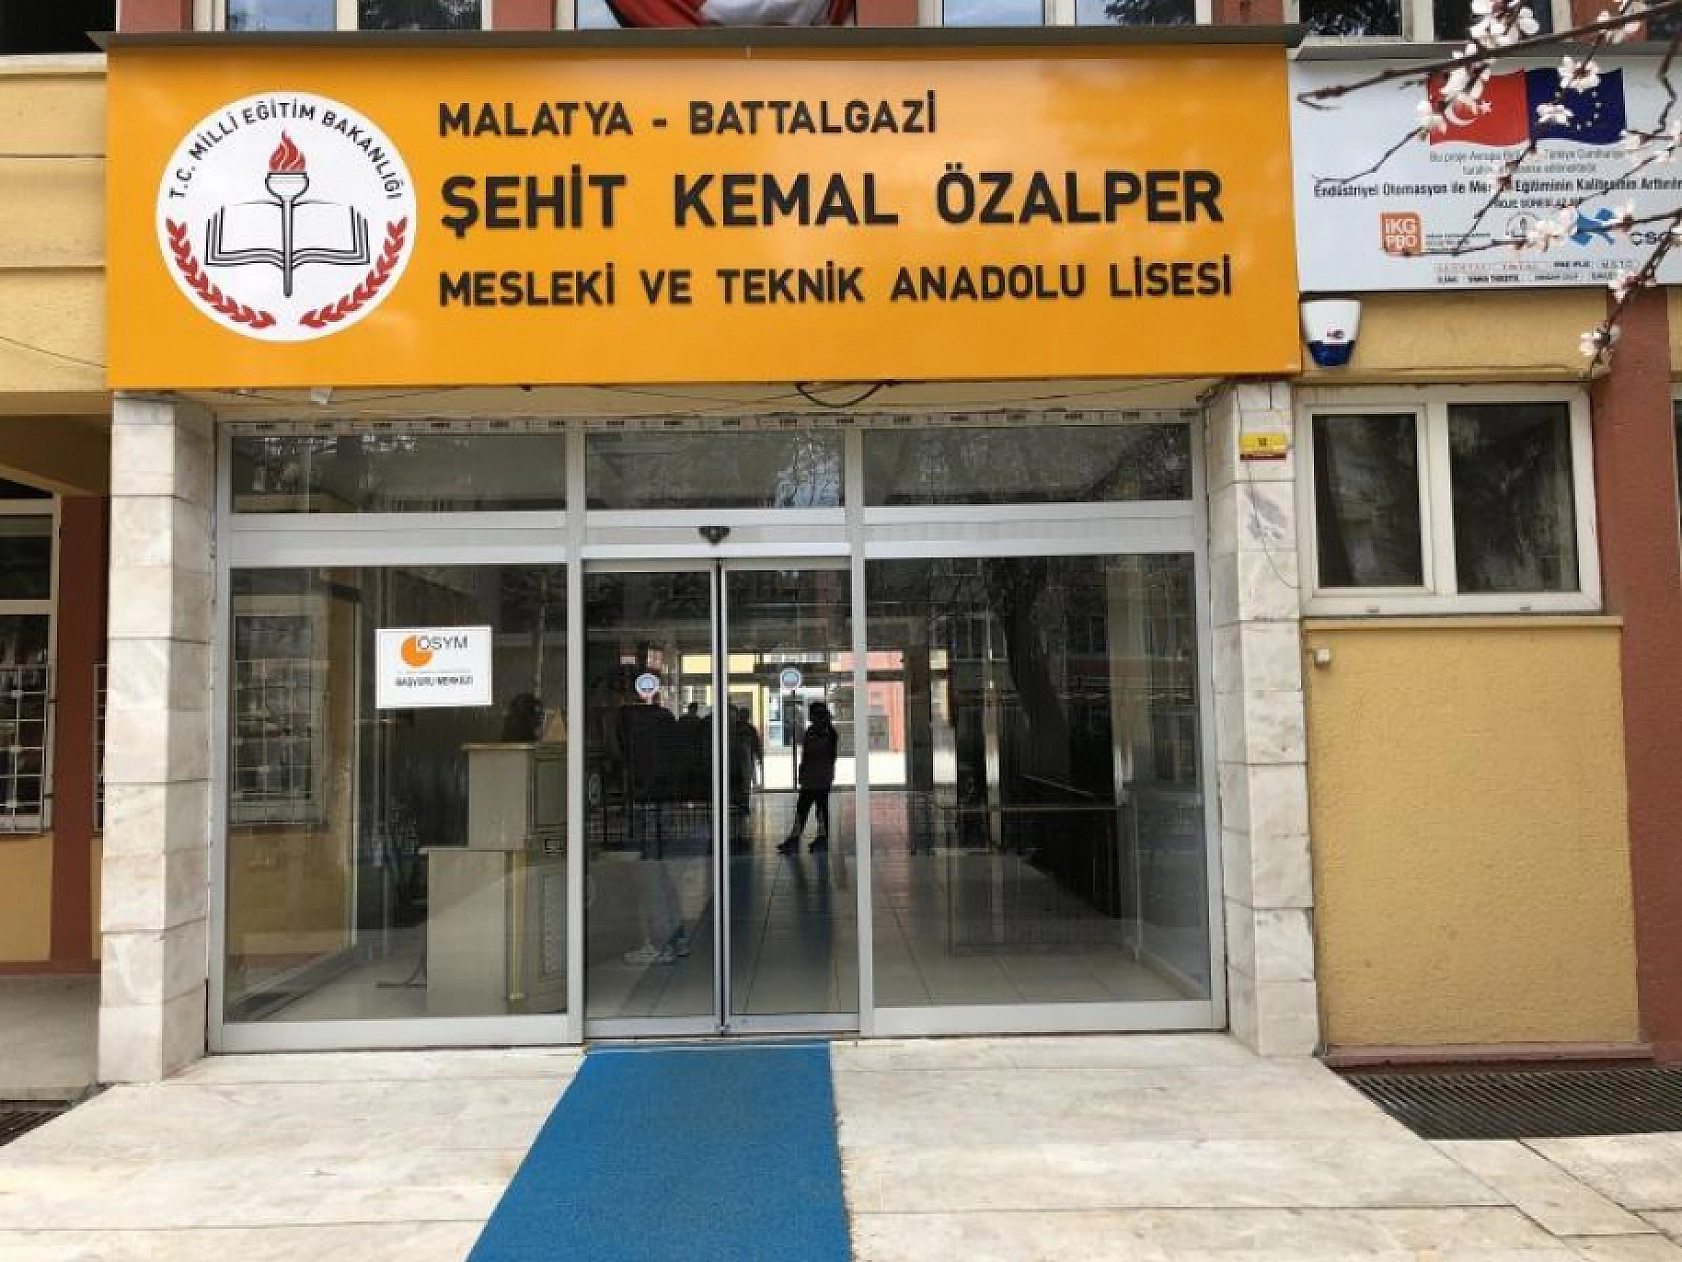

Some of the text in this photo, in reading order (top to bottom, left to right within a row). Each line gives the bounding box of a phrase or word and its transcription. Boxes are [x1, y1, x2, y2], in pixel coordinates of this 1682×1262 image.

[439, 101, 632, 137] MALATYA
[689, 90, 936, 135] BATTALGAZİ
[168, 97, 405, 200] T.C. MİLLİ EĞİTİM BAKANLIĞI
[441, 163, 1224, 237] ŞEHİT KEMAL ÖZALPER
[439, 254, 1232, 306] MESLEKİ VE TEKNİK ANADOLU LİSESİ
